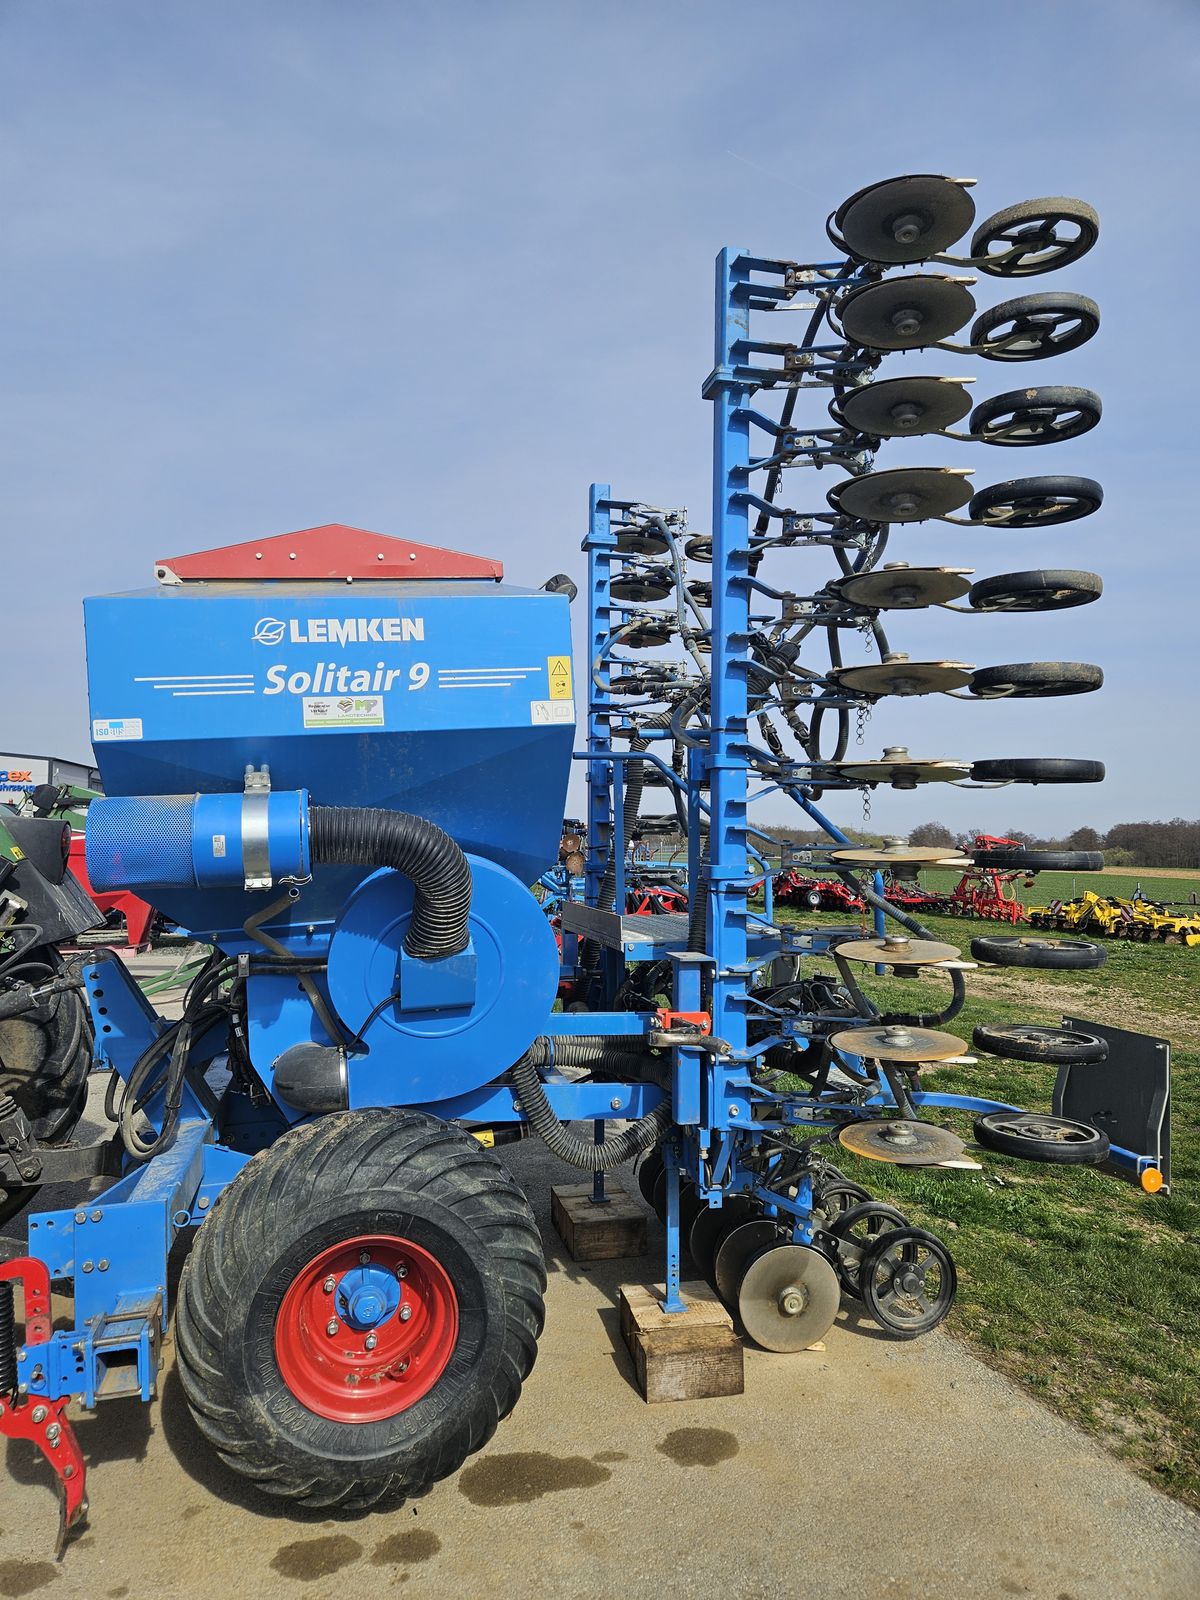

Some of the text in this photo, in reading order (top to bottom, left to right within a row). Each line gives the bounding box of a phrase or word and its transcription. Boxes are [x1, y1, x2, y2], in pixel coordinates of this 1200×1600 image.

[289, 617, 425, 648] LEMKEN
[263, 662, 430, 695] Solitair 9
[355, 699, 378, 713] MP
